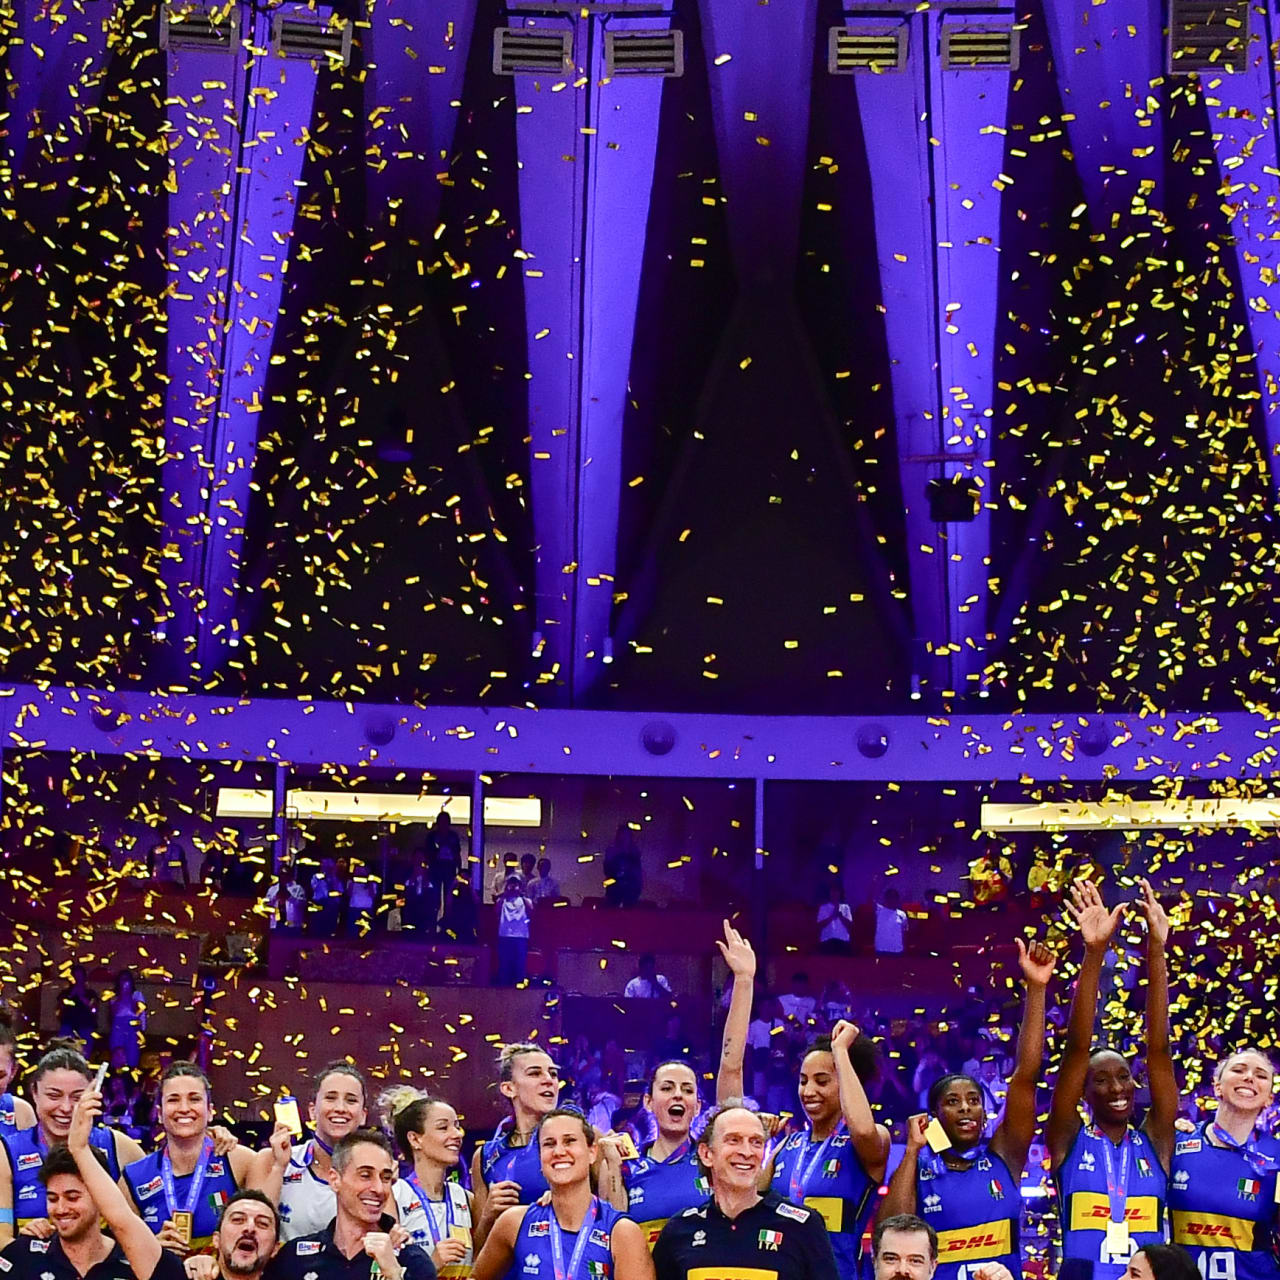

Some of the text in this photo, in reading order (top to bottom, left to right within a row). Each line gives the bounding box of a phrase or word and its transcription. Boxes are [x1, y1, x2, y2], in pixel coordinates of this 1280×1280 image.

[1237, 1191, 1256, 1202] ITA
[1091, 1204, 1143, 1220] DL
[1185, 1222, 1233, 1239] DHL
[759, 1240, 778, 1252] ITA
[948, 1233, 1000, 1252] DHL
